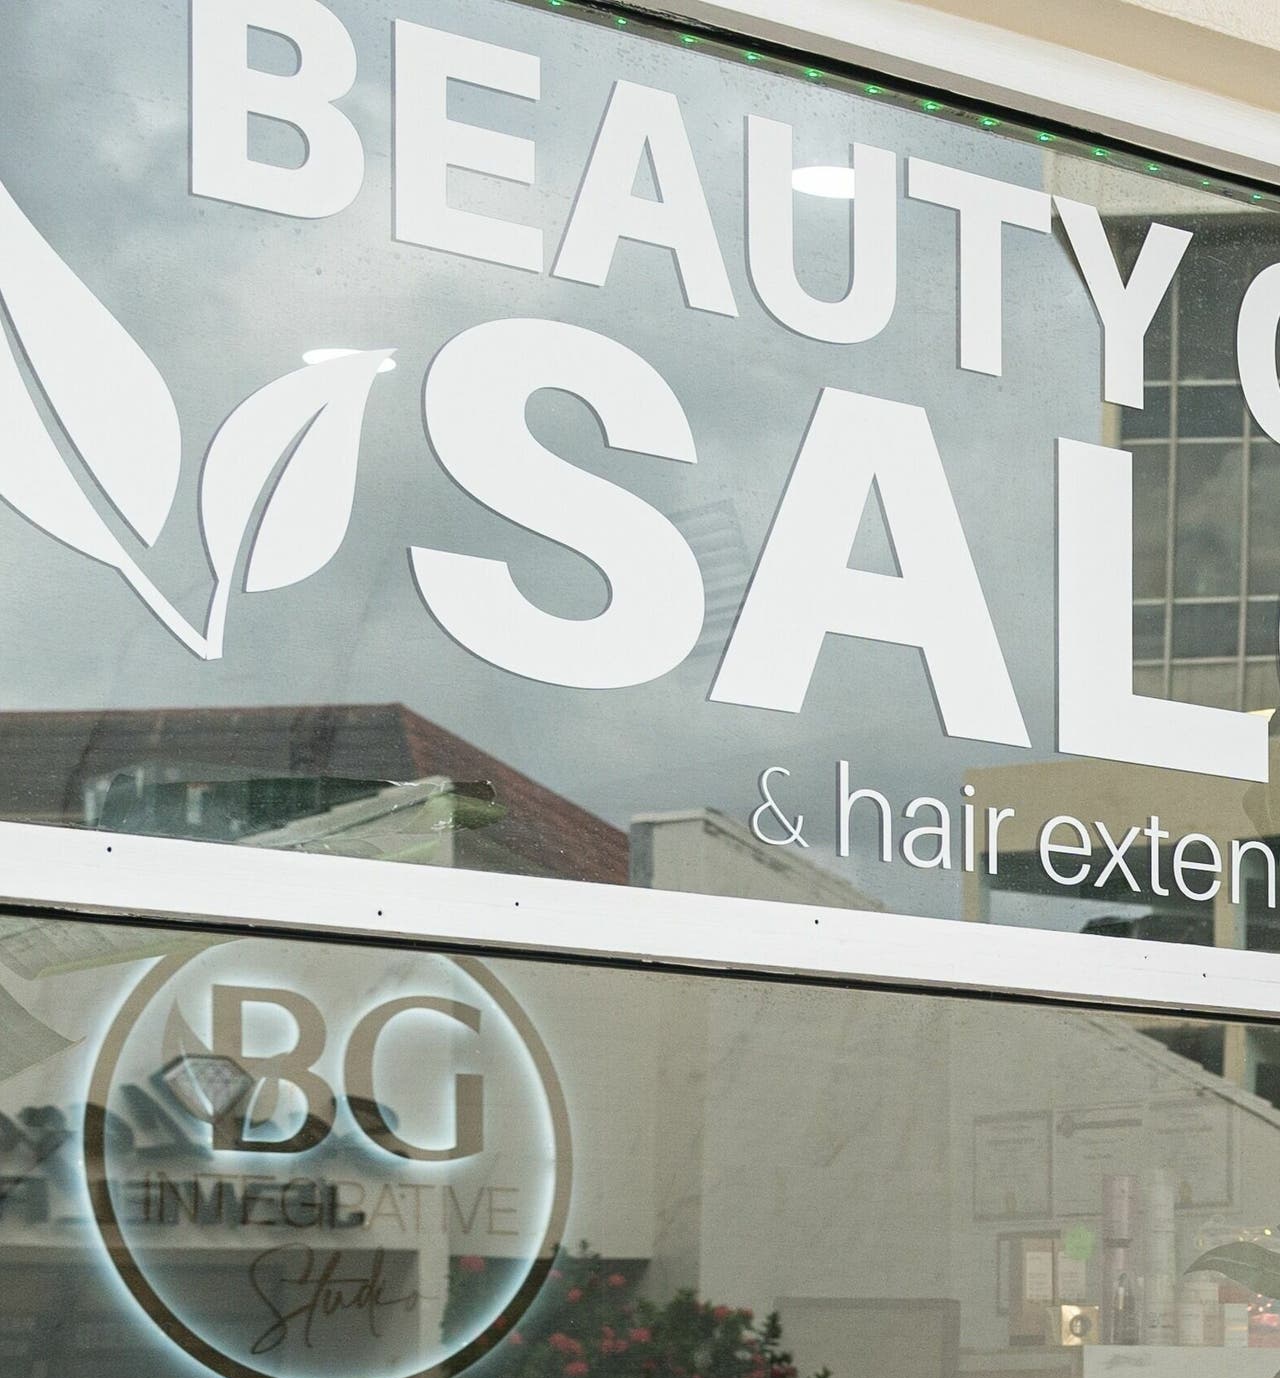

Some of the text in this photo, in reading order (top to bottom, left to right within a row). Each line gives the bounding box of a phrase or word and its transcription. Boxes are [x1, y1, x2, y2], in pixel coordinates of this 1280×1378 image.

[192, 0, 1194, 410] BEAUTY
[749, 765, 810, 849] &
[836, 759, 1015, 876] hair
[211, 984, 485, 1163] BG
[141, 1170, 520, 1237] INTEGRATIVE
[250, 1243, 430, 1355] Studio
